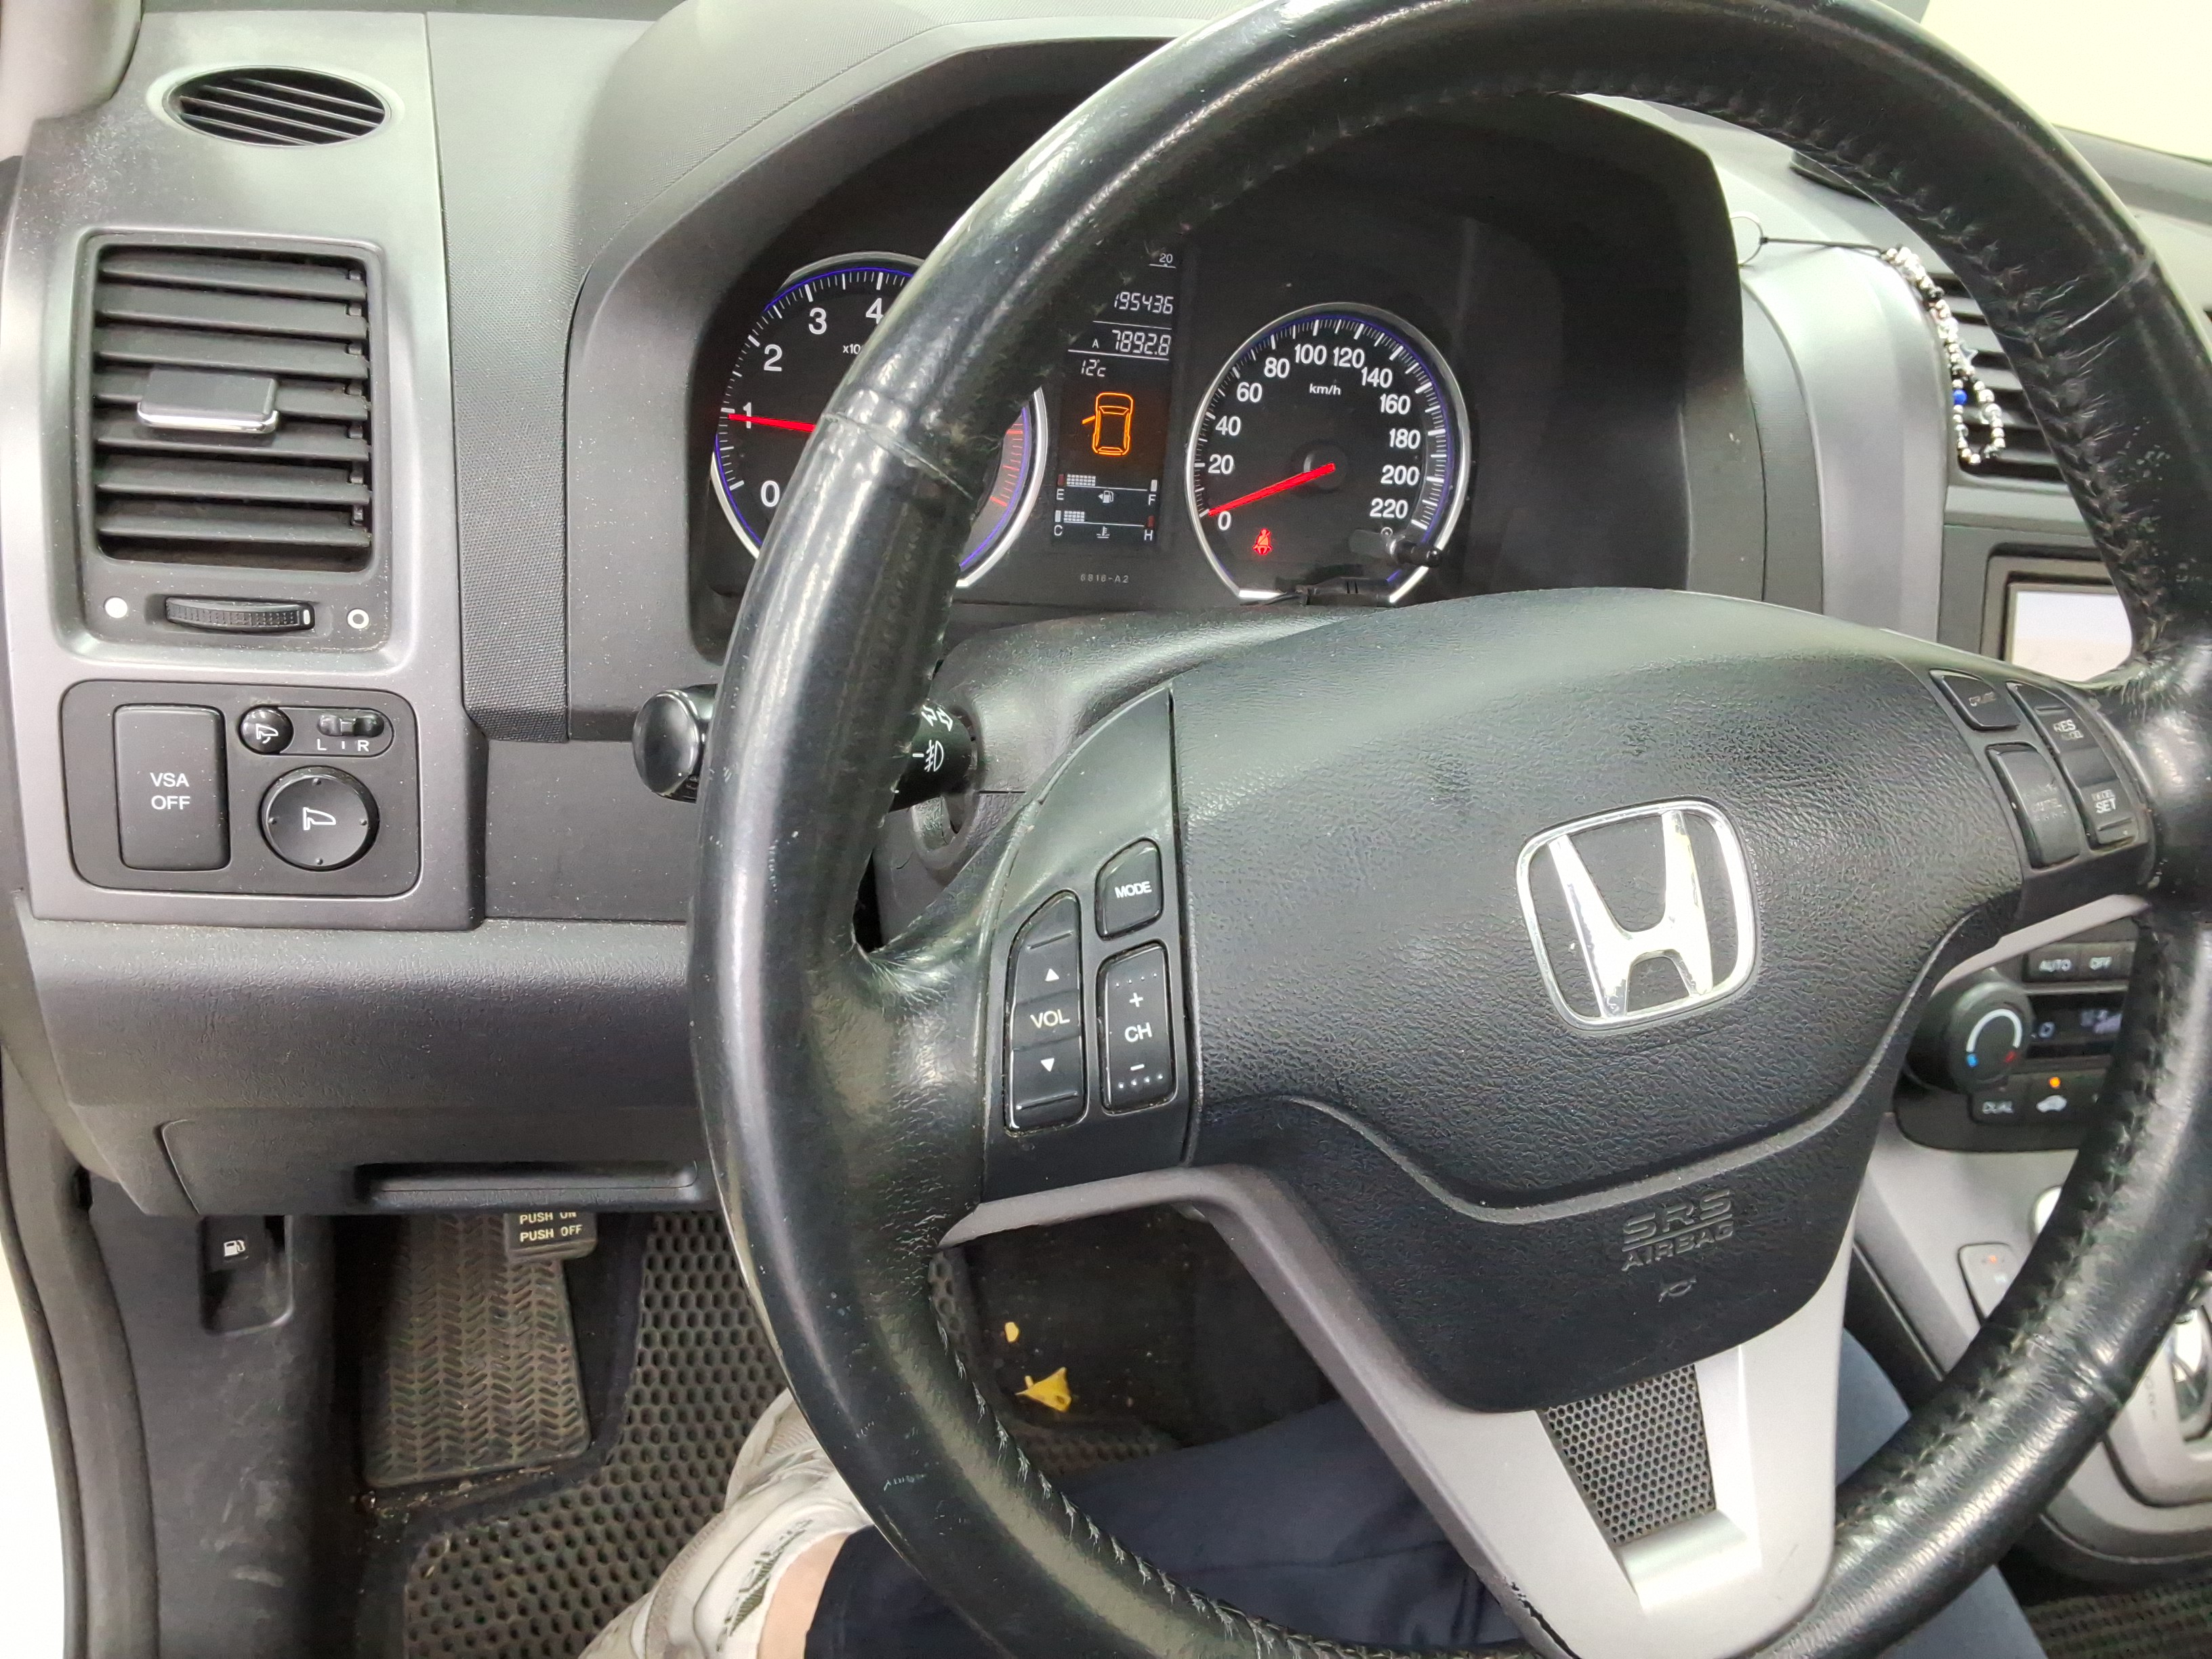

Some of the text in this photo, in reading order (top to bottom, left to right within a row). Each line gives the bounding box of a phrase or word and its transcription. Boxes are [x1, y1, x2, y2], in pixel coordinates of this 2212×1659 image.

[1159, 253, 1173, 264] 20
[865, 298, 884, 325] 4
[1113, 291, 1174, 314] 195436
[808, 307, 827, 335] 3
[842, 343, 861, 355] x10
[1092, 329, 1172, 356] A 7892.8
[764, 344, 782, 371] 2
[1294, 344, 1327, 365] 100
[1333, 347, 1365, 369] 120
[1264, 357, 1290, 378] 80
[1361, 367, 1393, 388] 140
[1237, 383, 1262, 403] 60
[1309, 384, 1341, 396] km/h
[1380, 394, 1410, 415] 160
[743, 402, 752, 429] 1
[1215, 416, 1242, 436] 40
[1389, 428, 1420, 449] 180
[1208, 455, 1234, 474] 20
[1380, 466, 1420, 485] 200
[760, 480, 780, 508] 0
[1057, 489, 1156, 506] E F
[1370, 498, 1408, 518] 220
[1217, 511, 1231, 530] 0
[1054, 525, 1153, 541] C H
[317, 739, 369, 752] L R
[150, 772, 189, 787] VSA
[150, 796, 190, 811] OFF
[2095, 798, 2116, 814] SET
[1115, 881, 1152, 899] MODE
[1030, 1010, 1070, 1029] VOL
[1124, 1023, 1152, 1042] CH
[519, 1212, 554, 1225] PUSH
[1623, 1190, 1732, 1244] SRS
[520, 1224, 583, 1242] PUSH OFF
[1621, 1221, 1734, 1271] AIRBAG
